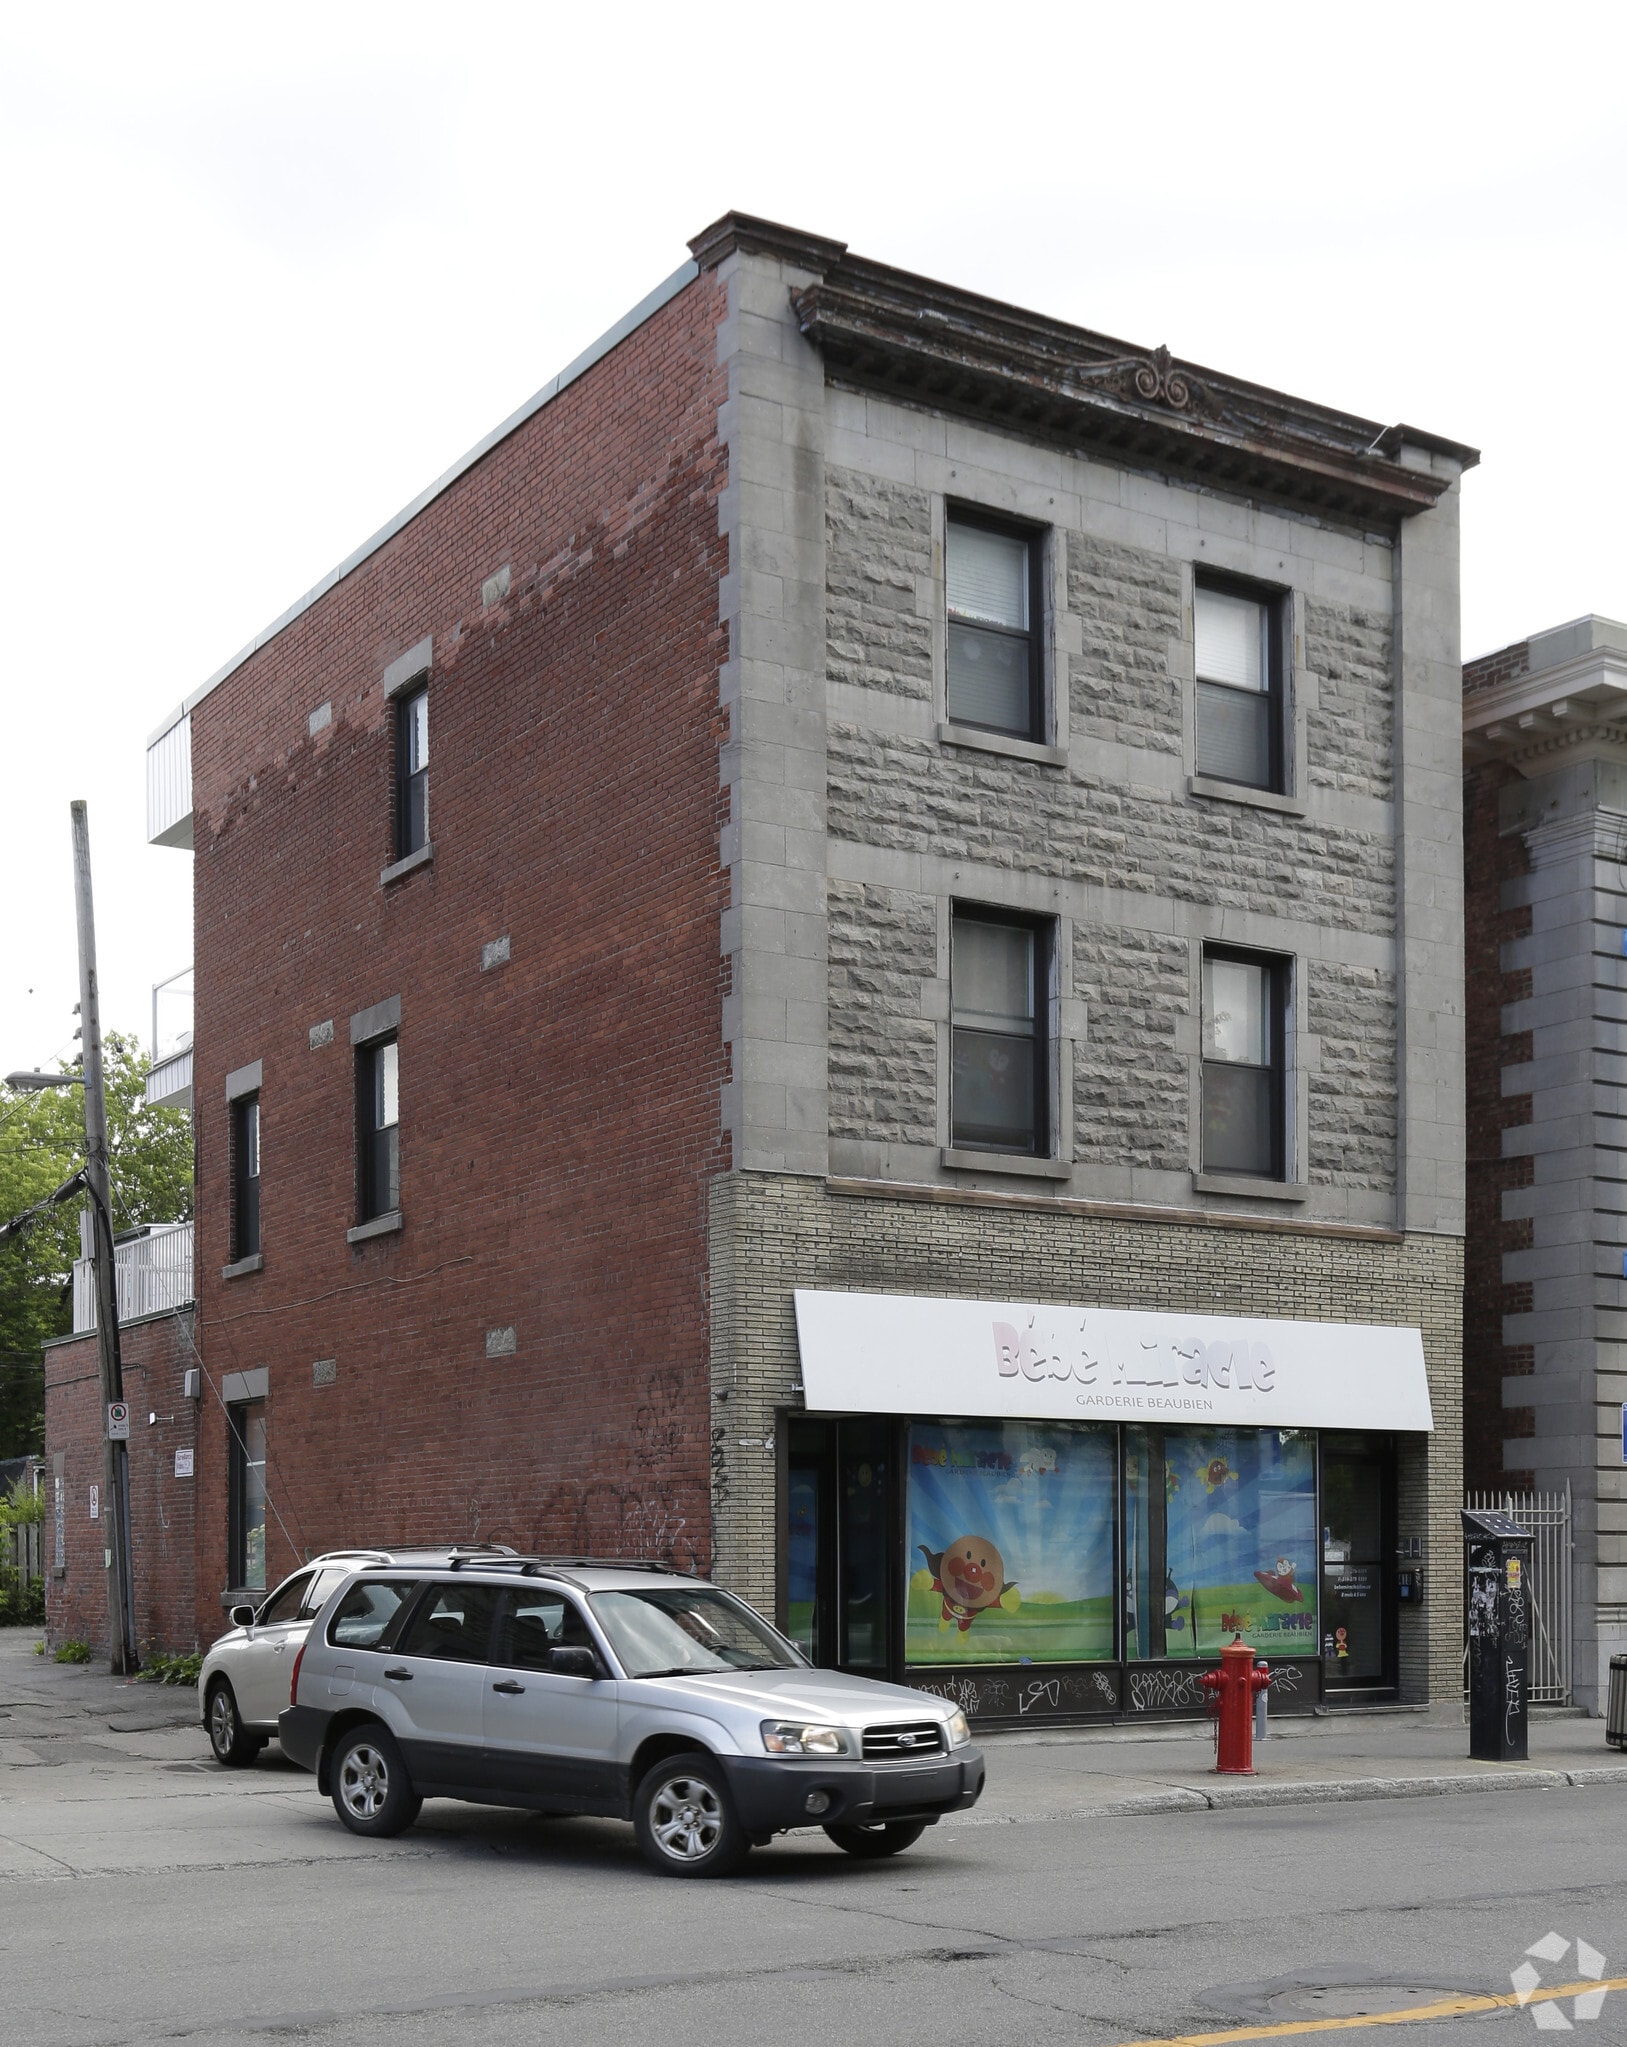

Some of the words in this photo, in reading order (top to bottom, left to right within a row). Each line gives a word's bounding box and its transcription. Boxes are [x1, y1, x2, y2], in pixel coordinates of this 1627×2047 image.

[991, 1312, 1099, 1385] Bébé
[1075, 1394, 1144, 1409] GARDERIE
[1147, 1397, 1213, 1411] BEAUBIEN
